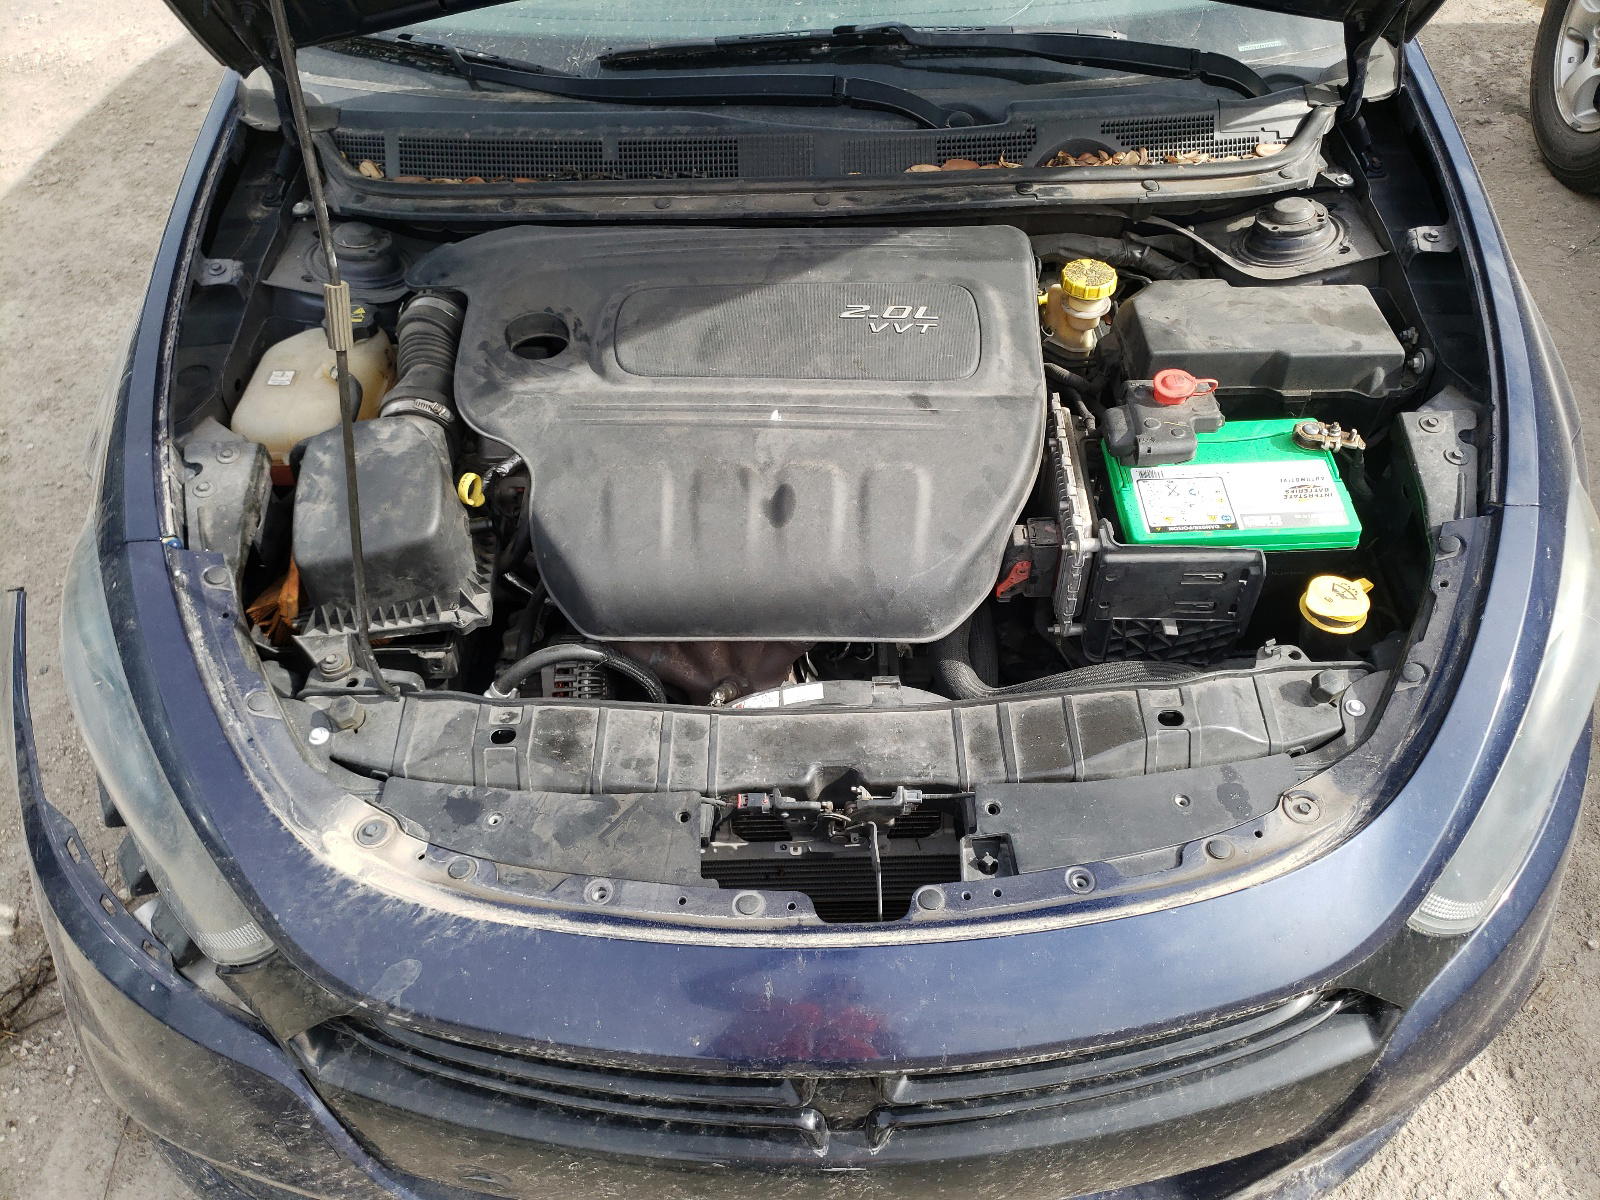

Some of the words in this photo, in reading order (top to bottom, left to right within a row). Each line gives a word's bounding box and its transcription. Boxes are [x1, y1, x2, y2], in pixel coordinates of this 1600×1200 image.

[839, 304, 939, 320] 2.0L
[869, 322, 938, 334] VVT
[1283, 492, 1333, 500] INTERSTATE
